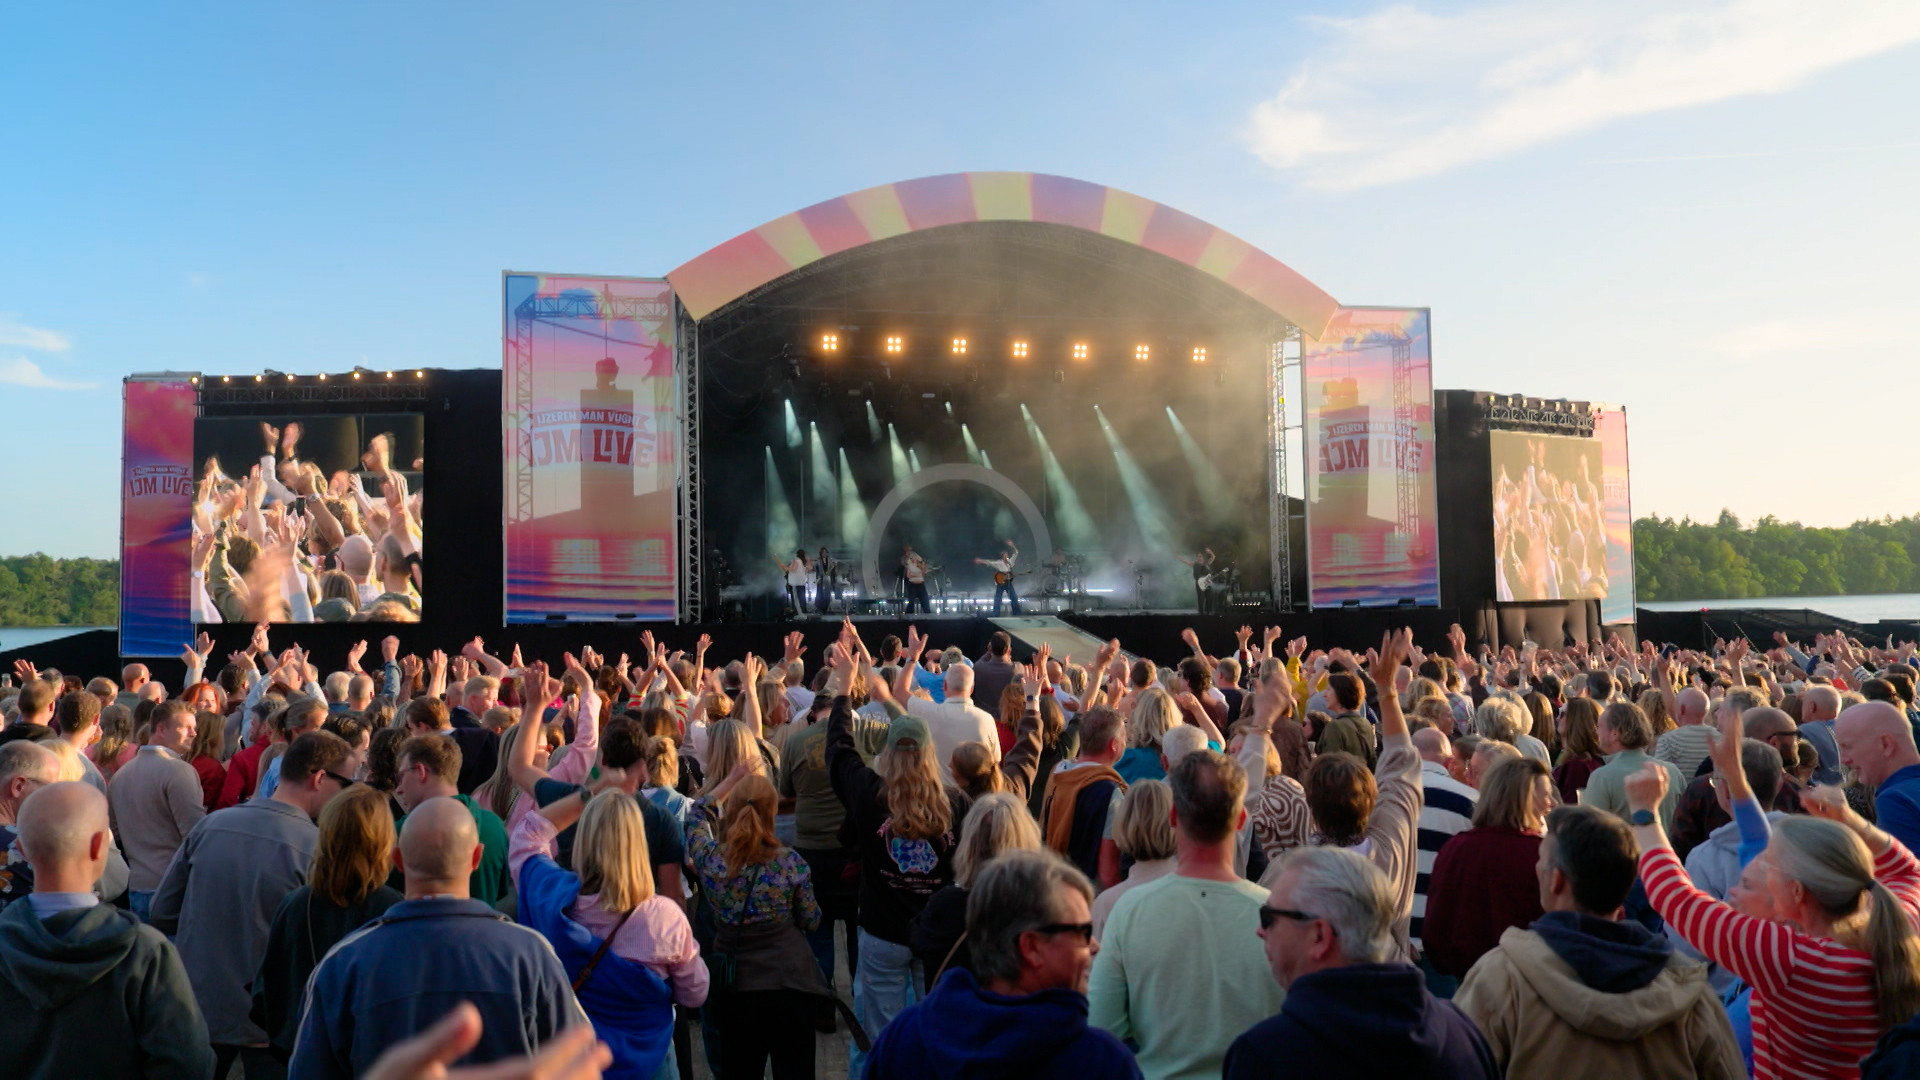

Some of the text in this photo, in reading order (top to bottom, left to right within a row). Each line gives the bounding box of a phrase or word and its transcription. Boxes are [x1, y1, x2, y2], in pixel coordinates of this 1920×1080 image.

[580, 410, 604, 421] MAN
[593, 429, 656, 468] LIVE
[1322, 439, 1369, 472] IJM
[130, 476, 192, 497] IJM LIVE
